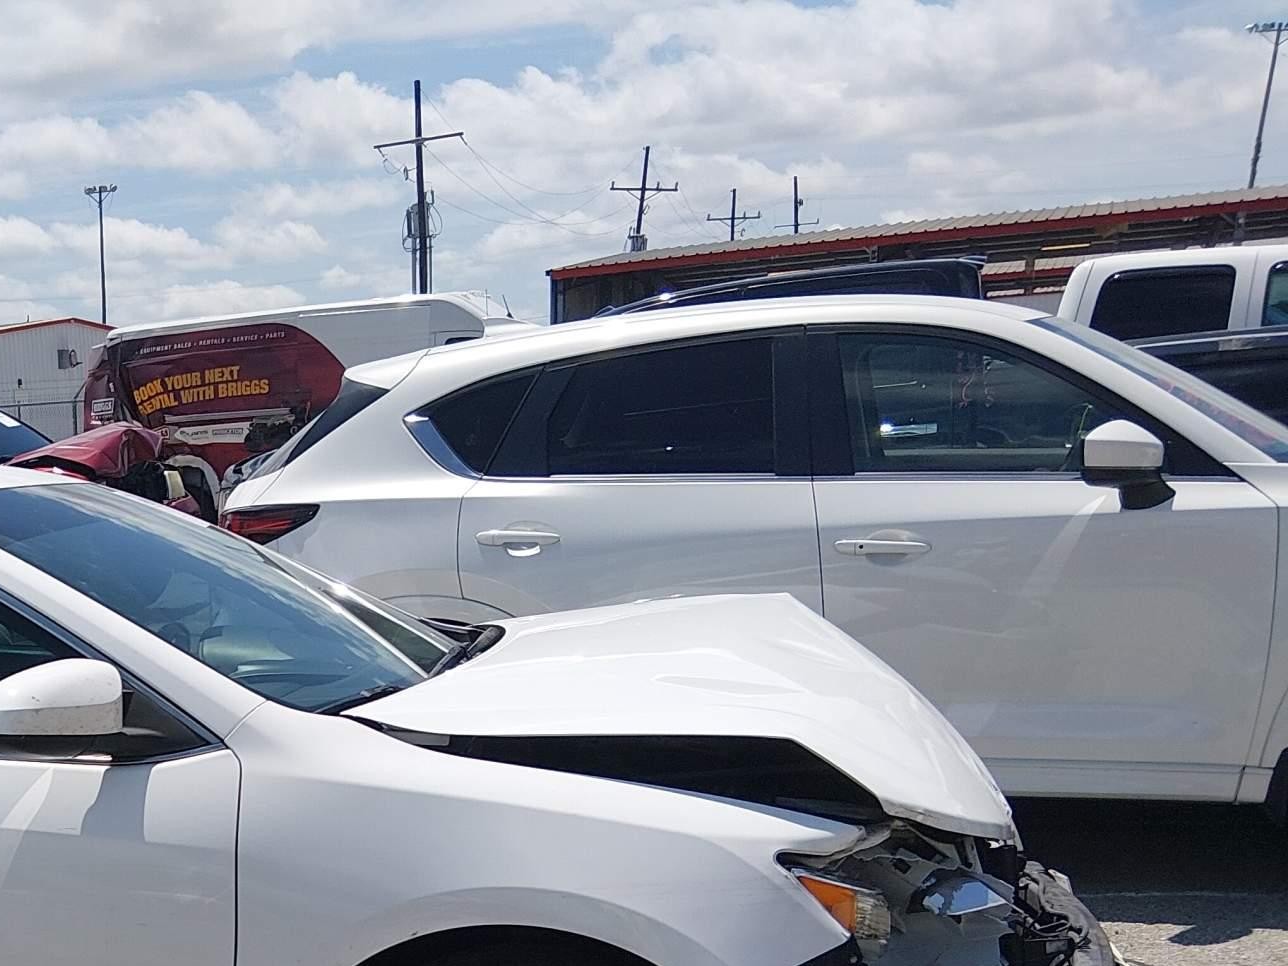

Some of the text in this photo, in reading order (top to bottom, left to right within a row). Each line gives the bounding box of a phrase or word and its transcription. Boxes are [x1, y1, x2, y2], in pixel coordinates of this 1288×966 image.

[140, 331, 285, 354] EQUIPMENT SALES RENTALS SERVICE PARTS
[133, 365, 241, 405] BOOK YOUR NEXT
[138, 379, 270, 416] RENTAL WITH BRIGGS
